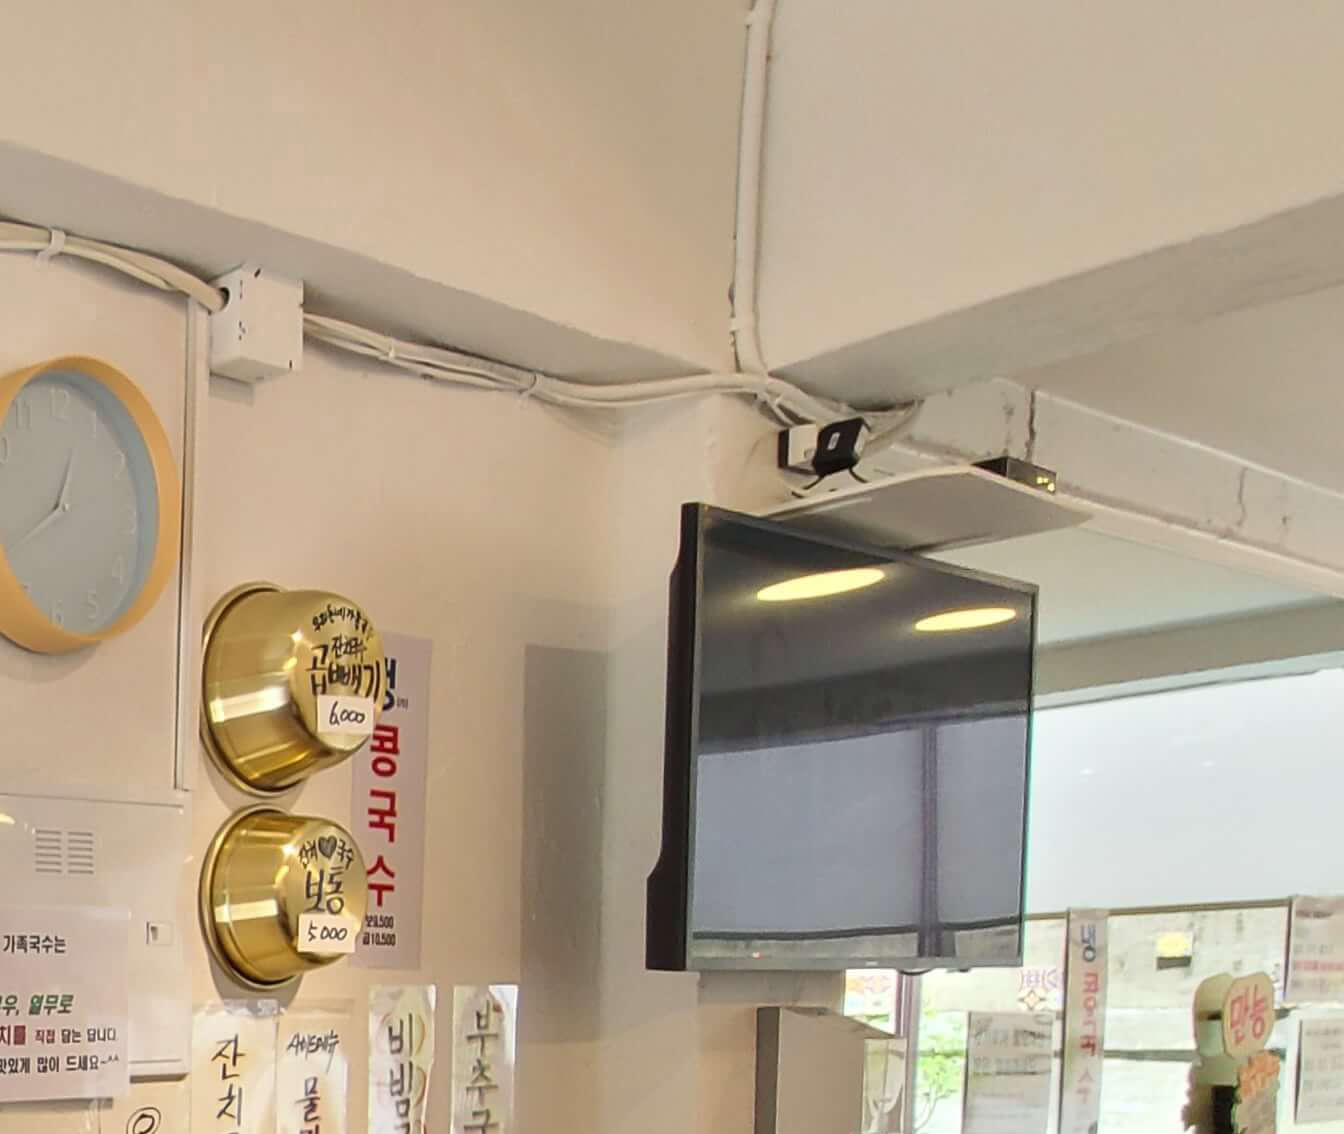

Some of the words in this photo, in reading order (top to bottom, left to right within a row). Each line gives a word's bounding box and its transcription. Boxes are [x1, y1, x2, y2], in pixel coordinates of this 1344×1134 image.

[304, 866, 345, 916] 보통
[2, 934, 67, 955] 가족국수는
[28, 993, 75, 1017] 열무로
[36, 1056, 60, 1074] 많이
